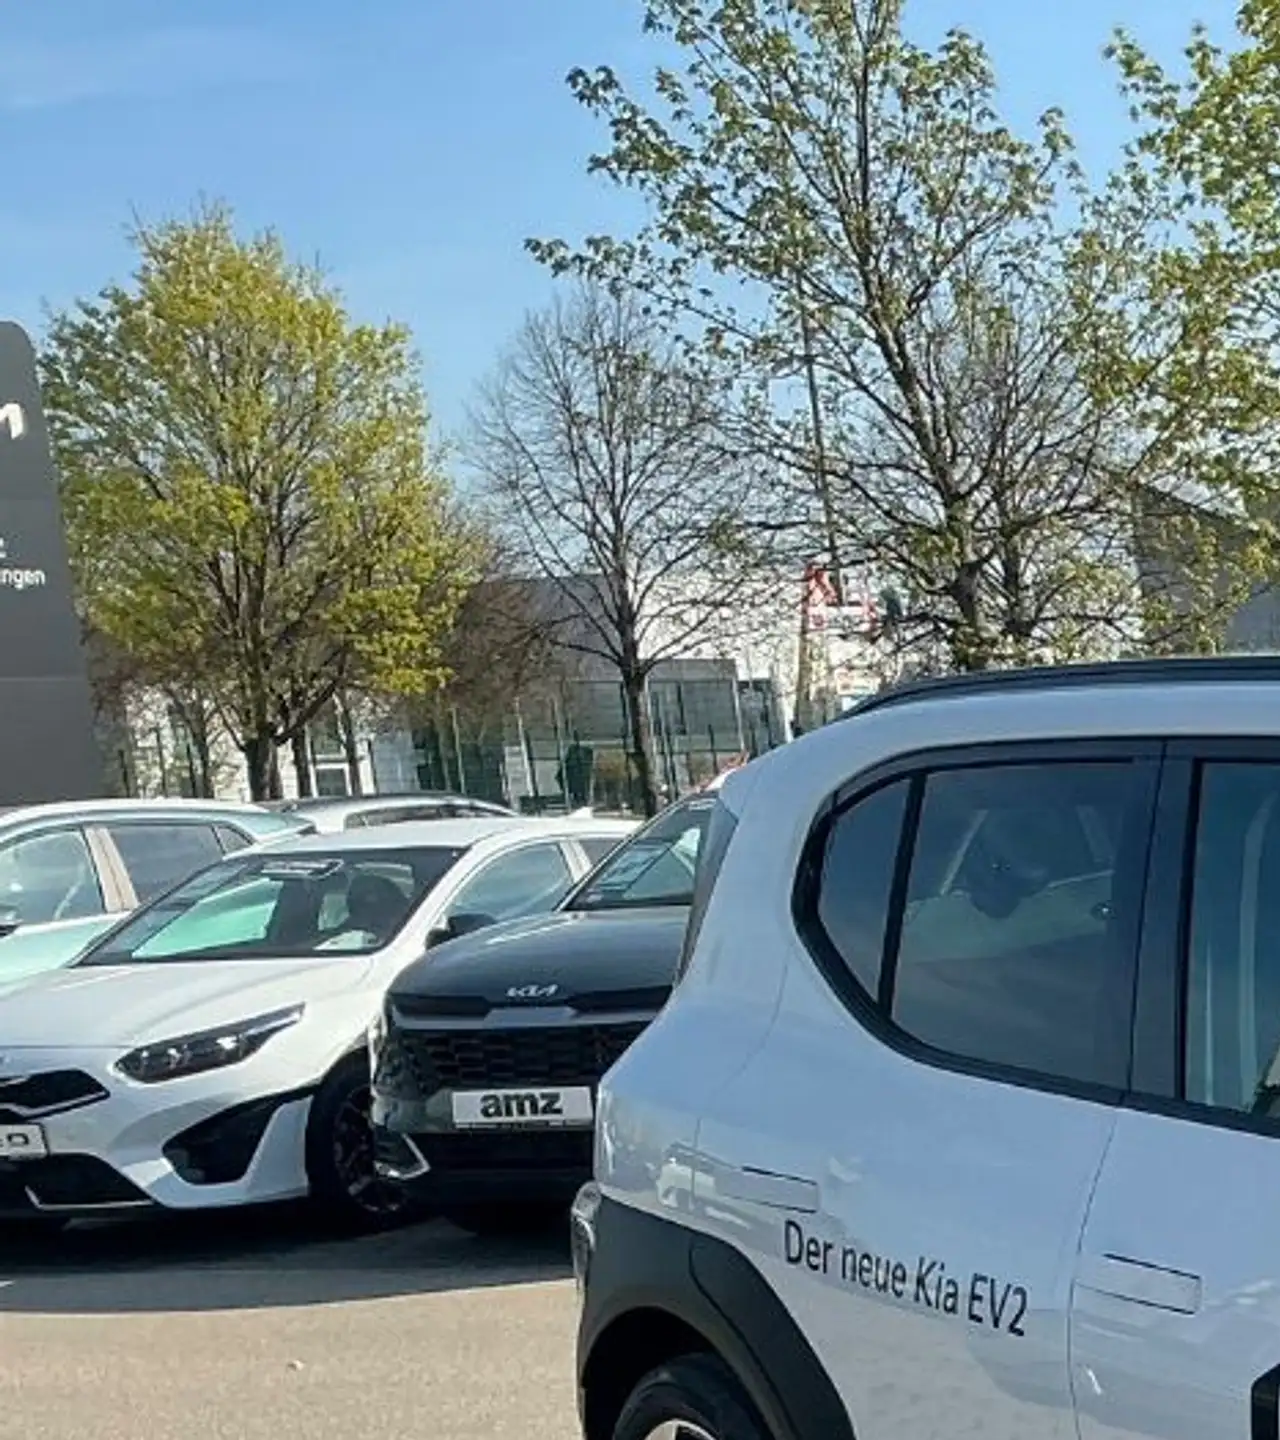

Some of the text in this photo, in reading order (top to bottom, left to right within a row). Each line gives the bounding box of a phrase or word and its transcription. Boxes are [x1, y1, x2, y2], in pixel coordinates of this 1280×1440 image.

[0, 568, 46, 590] ngen
[480, 1092, 563, 1118] amz
[785, 1219, 1028, 1337] Der neue Kia EV2
